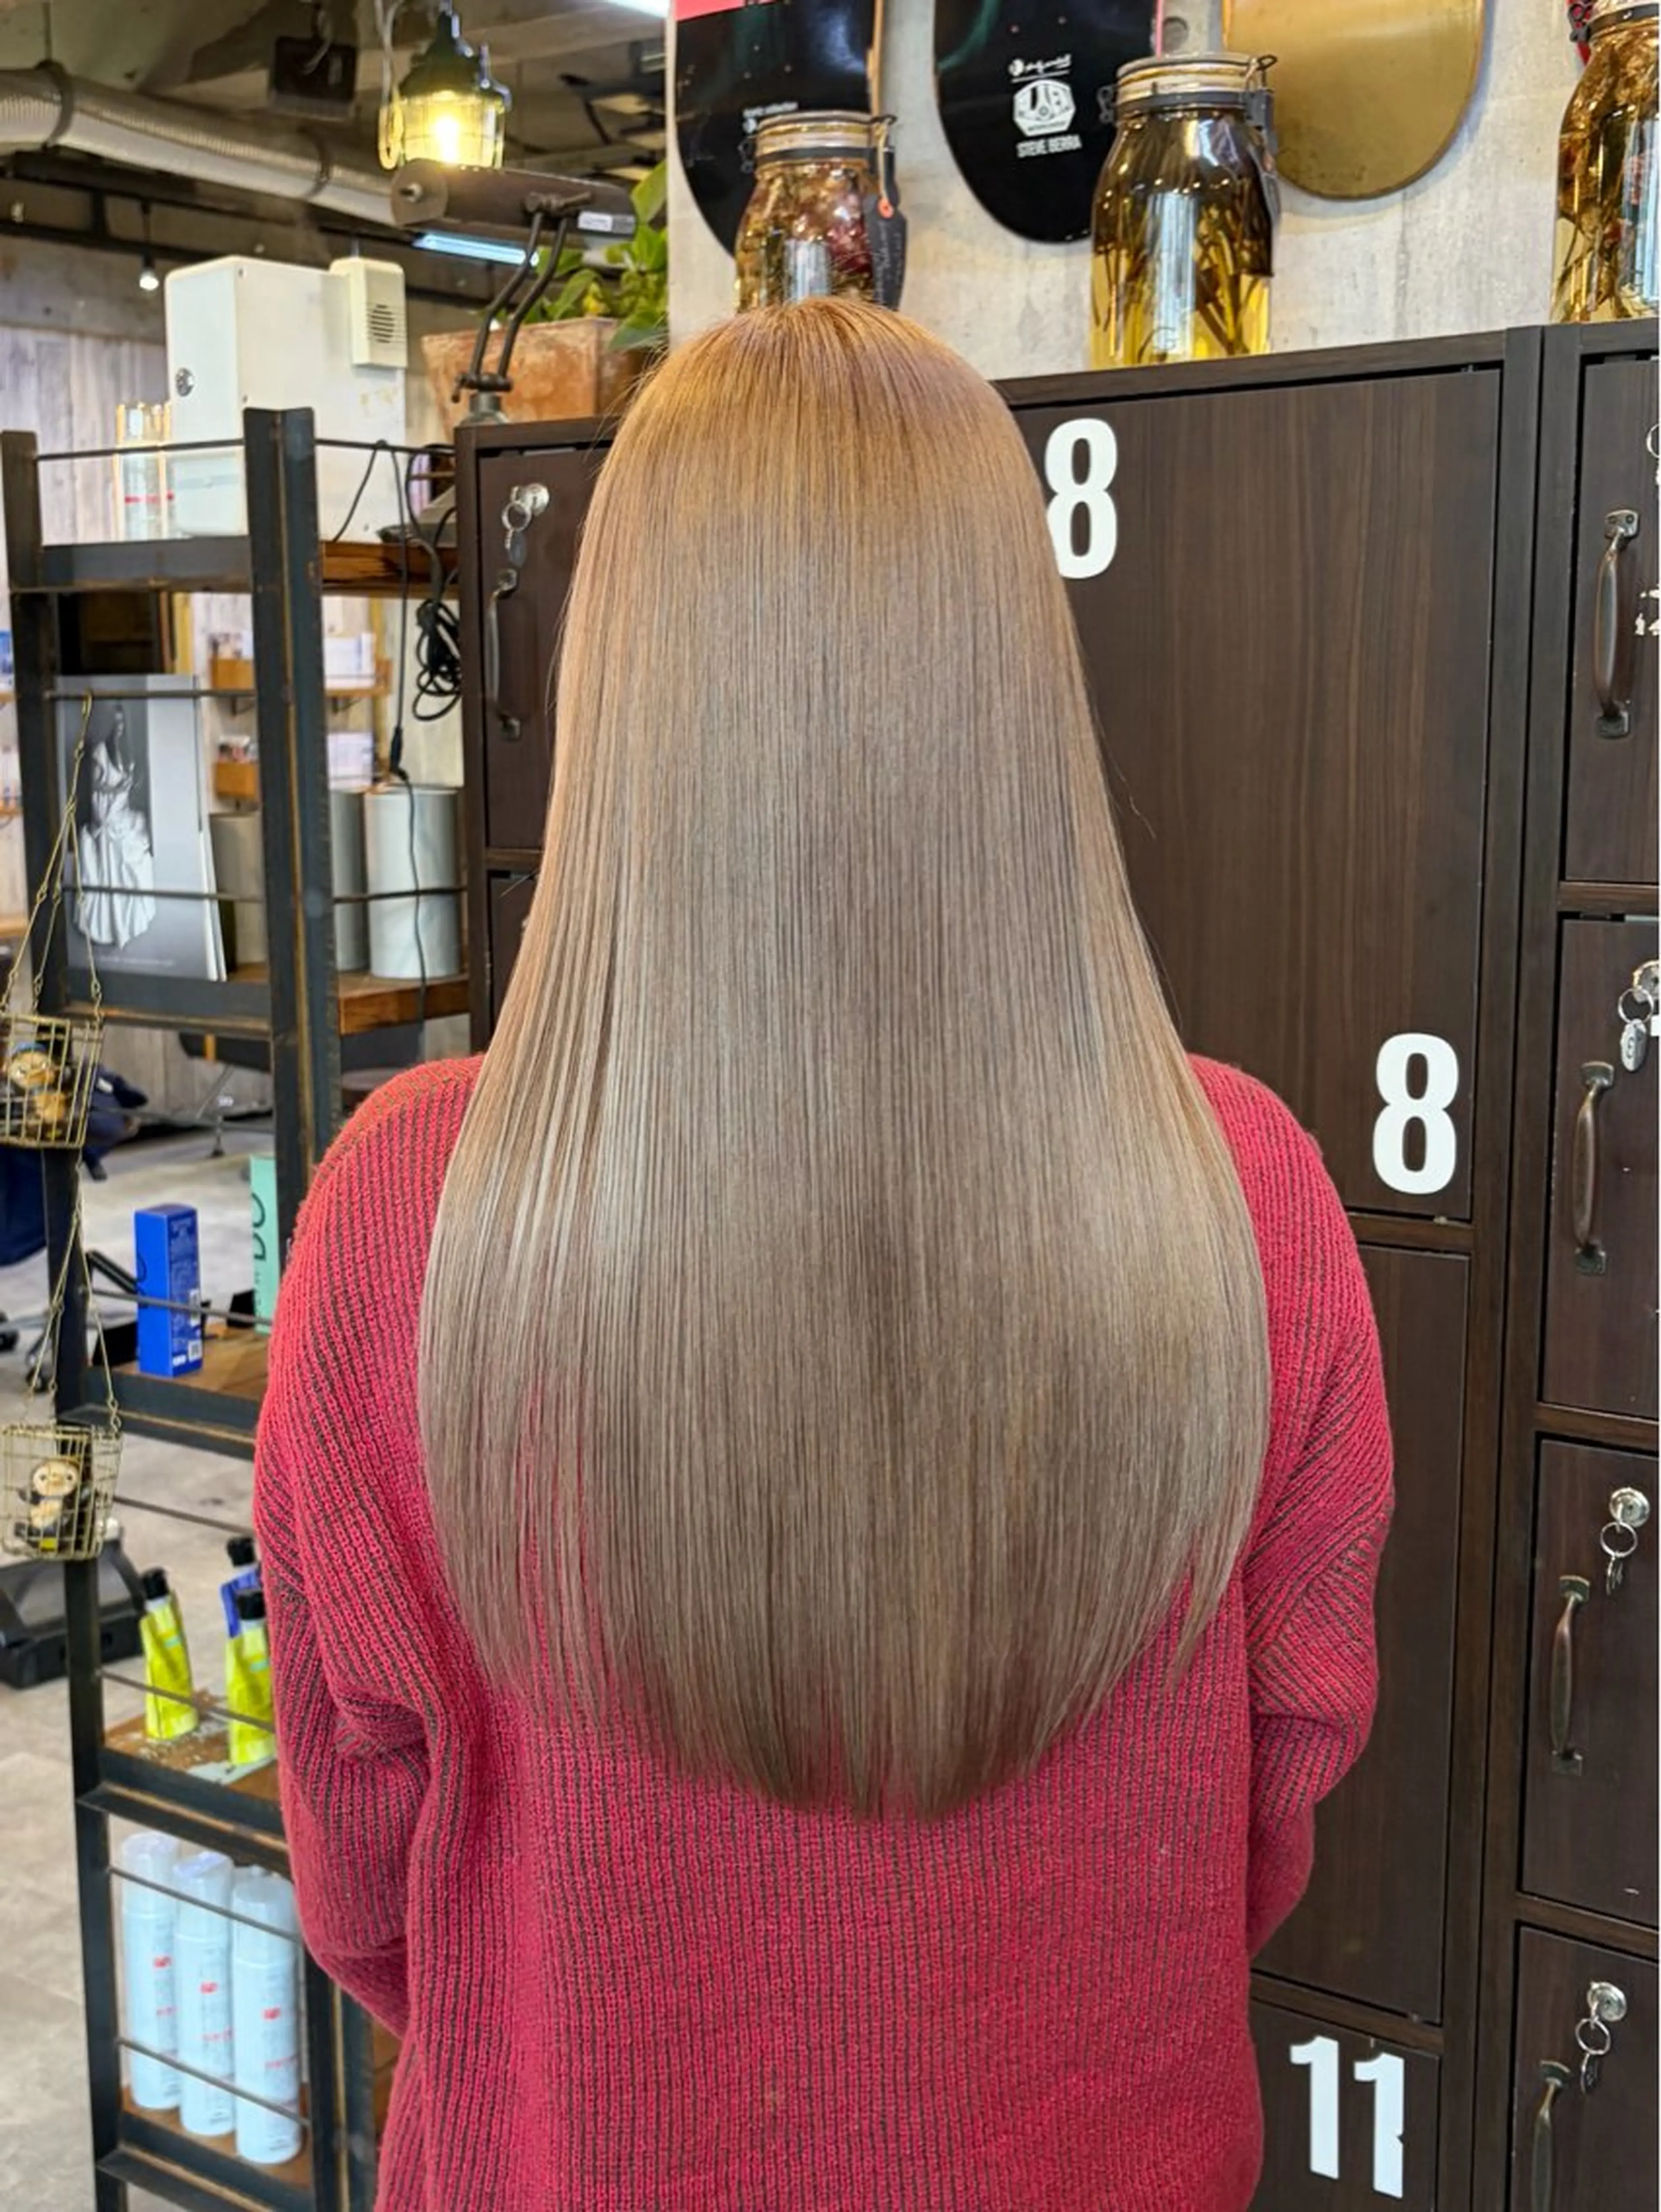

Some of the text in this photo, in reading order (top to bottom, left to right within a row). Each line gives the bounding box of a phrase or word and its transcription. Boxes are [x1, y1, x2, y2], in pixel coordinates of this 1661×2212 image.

[1045, 418, 1117, 579] 8
[1372, 1033, 1459, 1194] 8
[1289, 2035, 1404, 2199] 11
